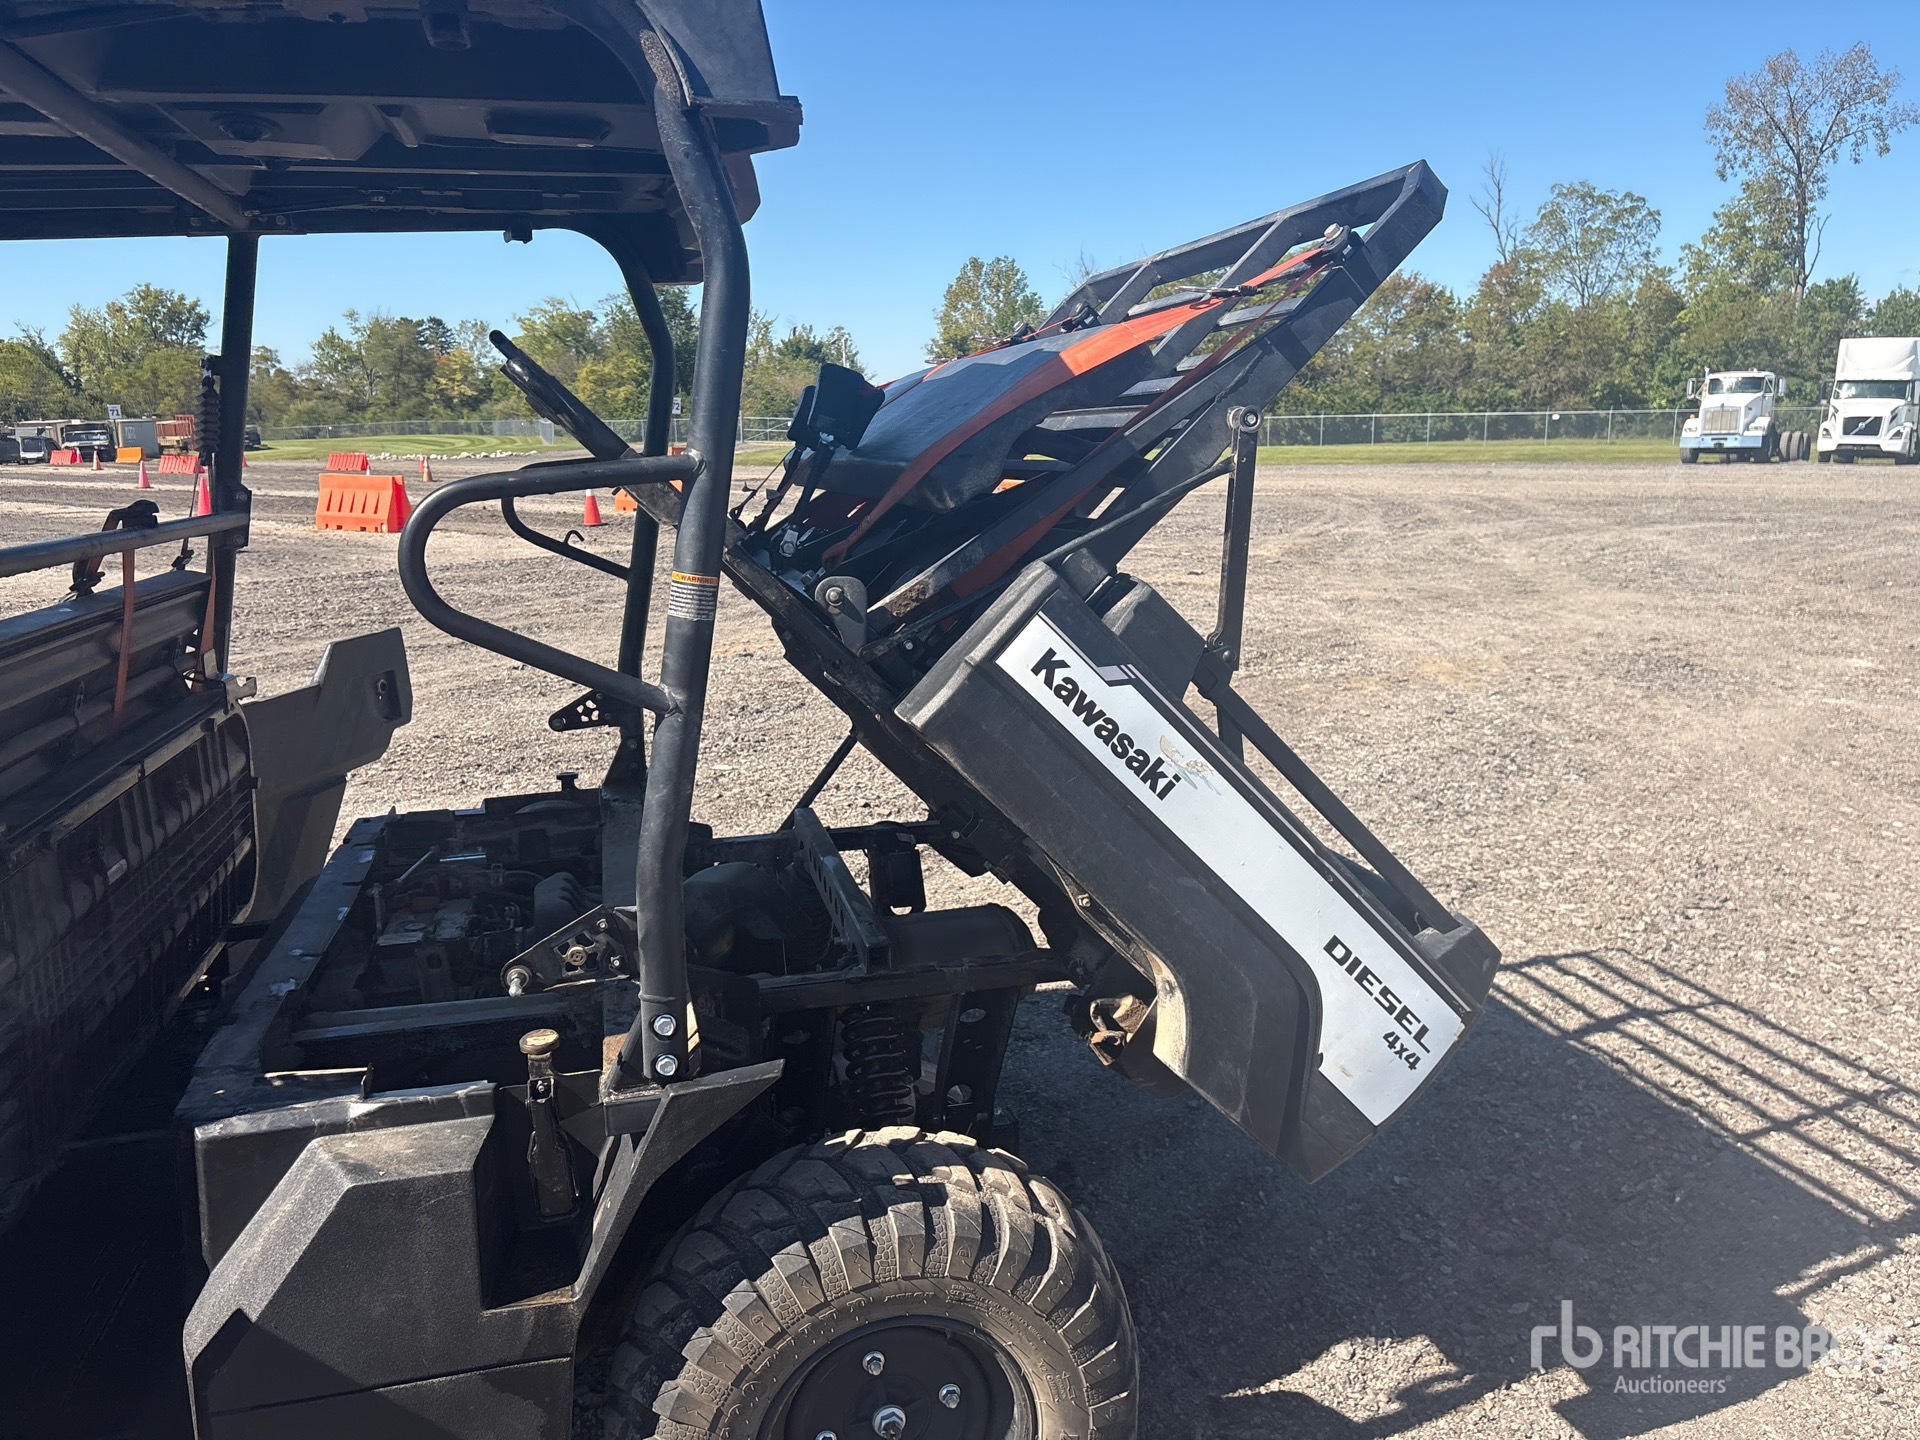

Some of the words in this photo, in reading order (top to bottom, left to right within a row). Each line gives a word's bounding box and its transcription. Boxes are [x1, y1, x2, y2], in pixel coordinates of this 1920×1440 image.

[681, 574, 714, 584] WARNING
[1031, 647, 1182, 801] Kawasaki
[1323, 934, 1430, 1054] DIESEL
[1382, 1031, 1421, 1071] 4x4
